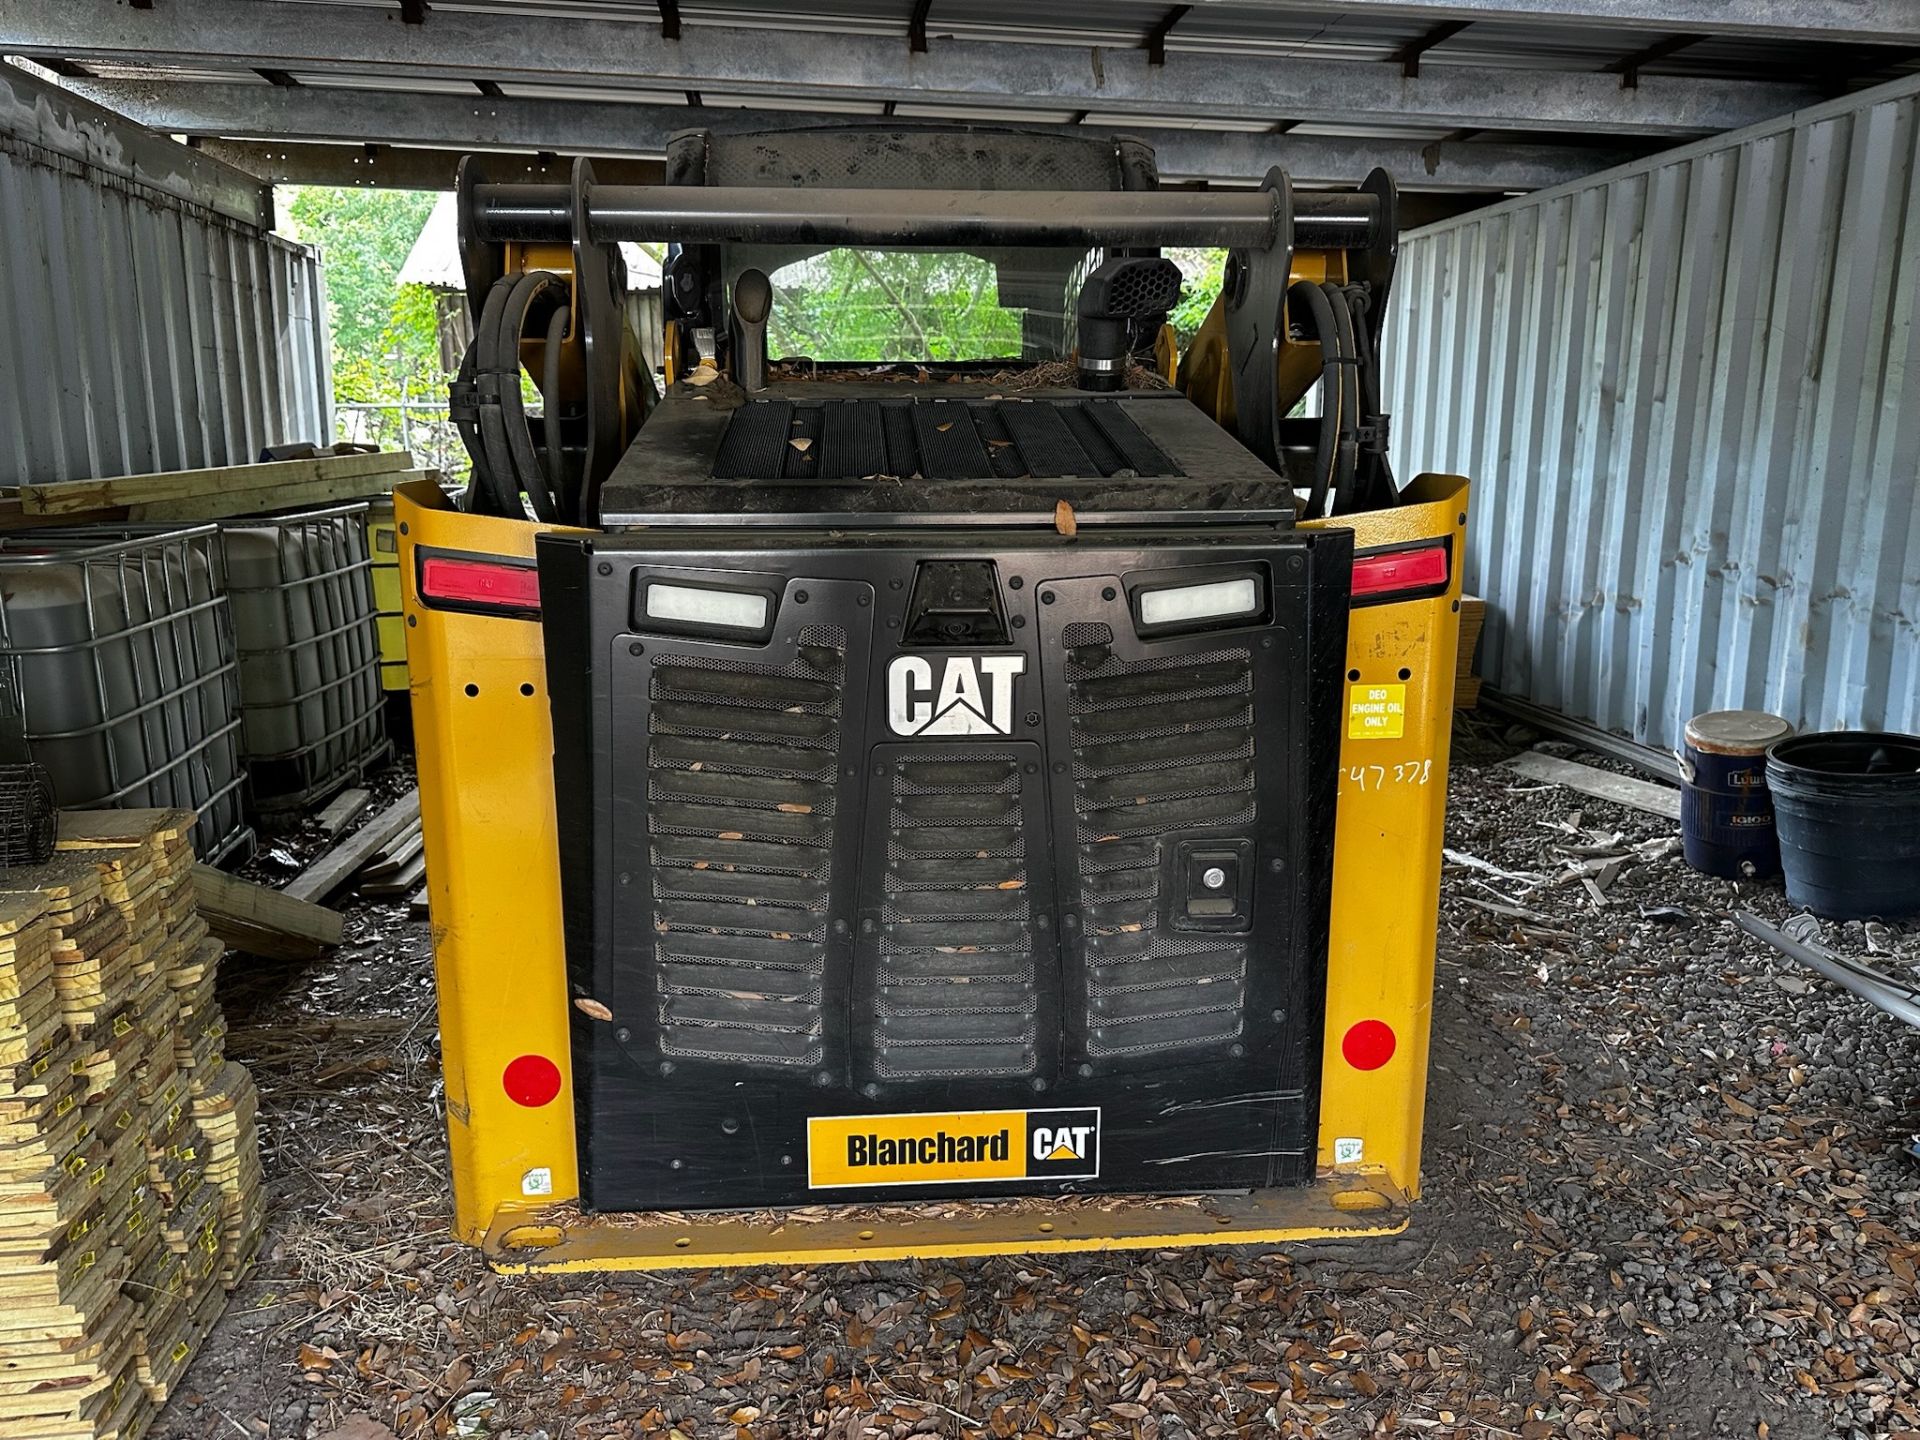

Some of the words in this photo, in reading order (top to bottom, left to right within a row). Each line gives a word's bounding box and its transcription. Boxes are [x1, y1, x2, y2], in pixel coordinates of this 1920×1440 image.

[888, 655, 1025, 737] CAT
[1368, 689, 1388, 700] DEO
[1352, 703, 1385, 714] ENGINE
[1387, 702, 1402, 713] OIL
[1364, 716, 1388, 727] ONLY
[847, 1128, 1010, 1167] Blanchard
[1033, 1126, 1090, 1161] CAT
